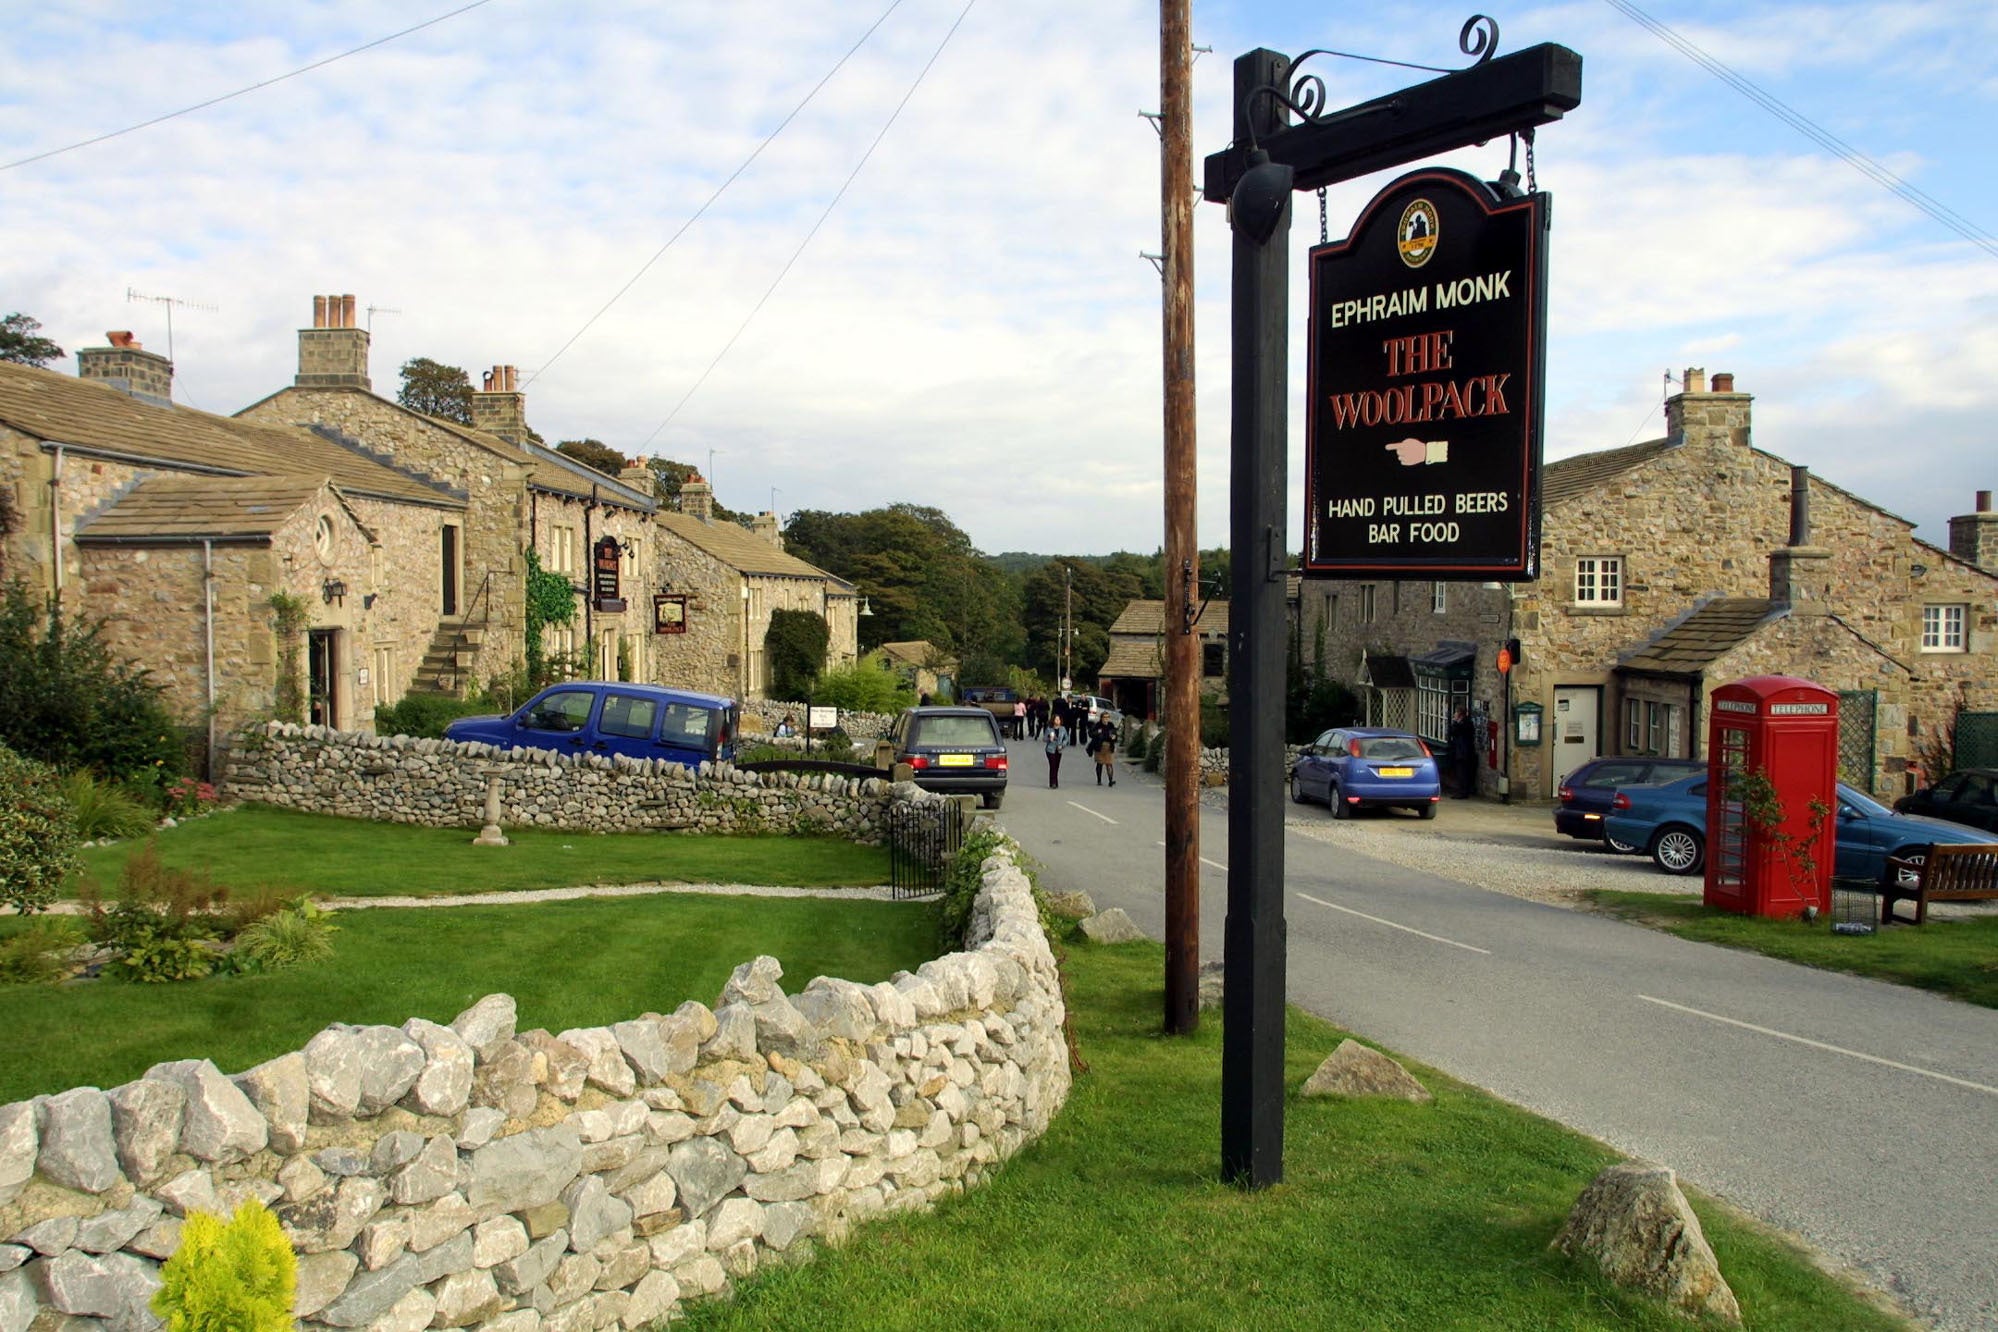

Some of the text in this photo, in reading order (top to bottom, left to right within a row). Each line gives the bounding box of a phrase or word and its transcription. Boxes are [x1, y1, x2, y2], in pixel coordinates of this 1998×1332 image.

[1331, 270, 1512, 329] EPHRAIM MONK
[1383, 330, 1454, 377] THE
[1329, 372, 1511, 431] WOOLPACK
[1328, 491, 1508, 518] HAND PULLED BEERS
[1368, 522, 1460, 544] BAR FOOD
[1773, 704, 1826, 714] TELEPHONE
